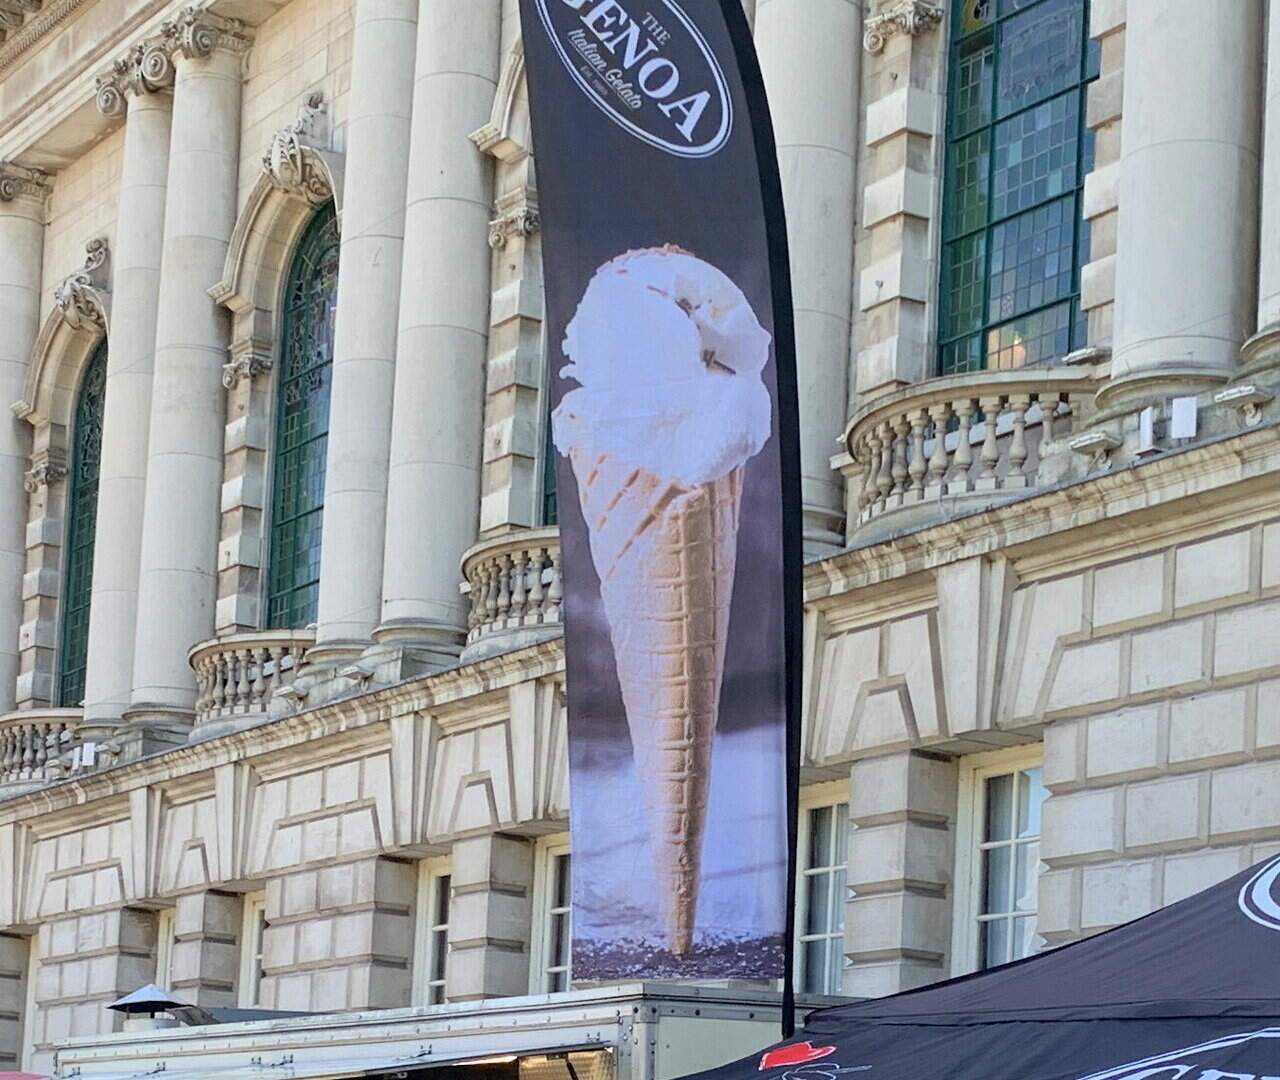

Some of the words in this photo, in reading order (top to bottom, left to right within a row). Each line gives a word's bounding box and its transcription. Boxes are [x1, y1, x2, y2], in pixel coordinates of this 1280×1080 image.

[568, 28, 608, 71] Italian
[605, 68, 642, 109] Gelato
[642, 11, 671, 47] THE
[562, 0, 710, 142] ENOA
